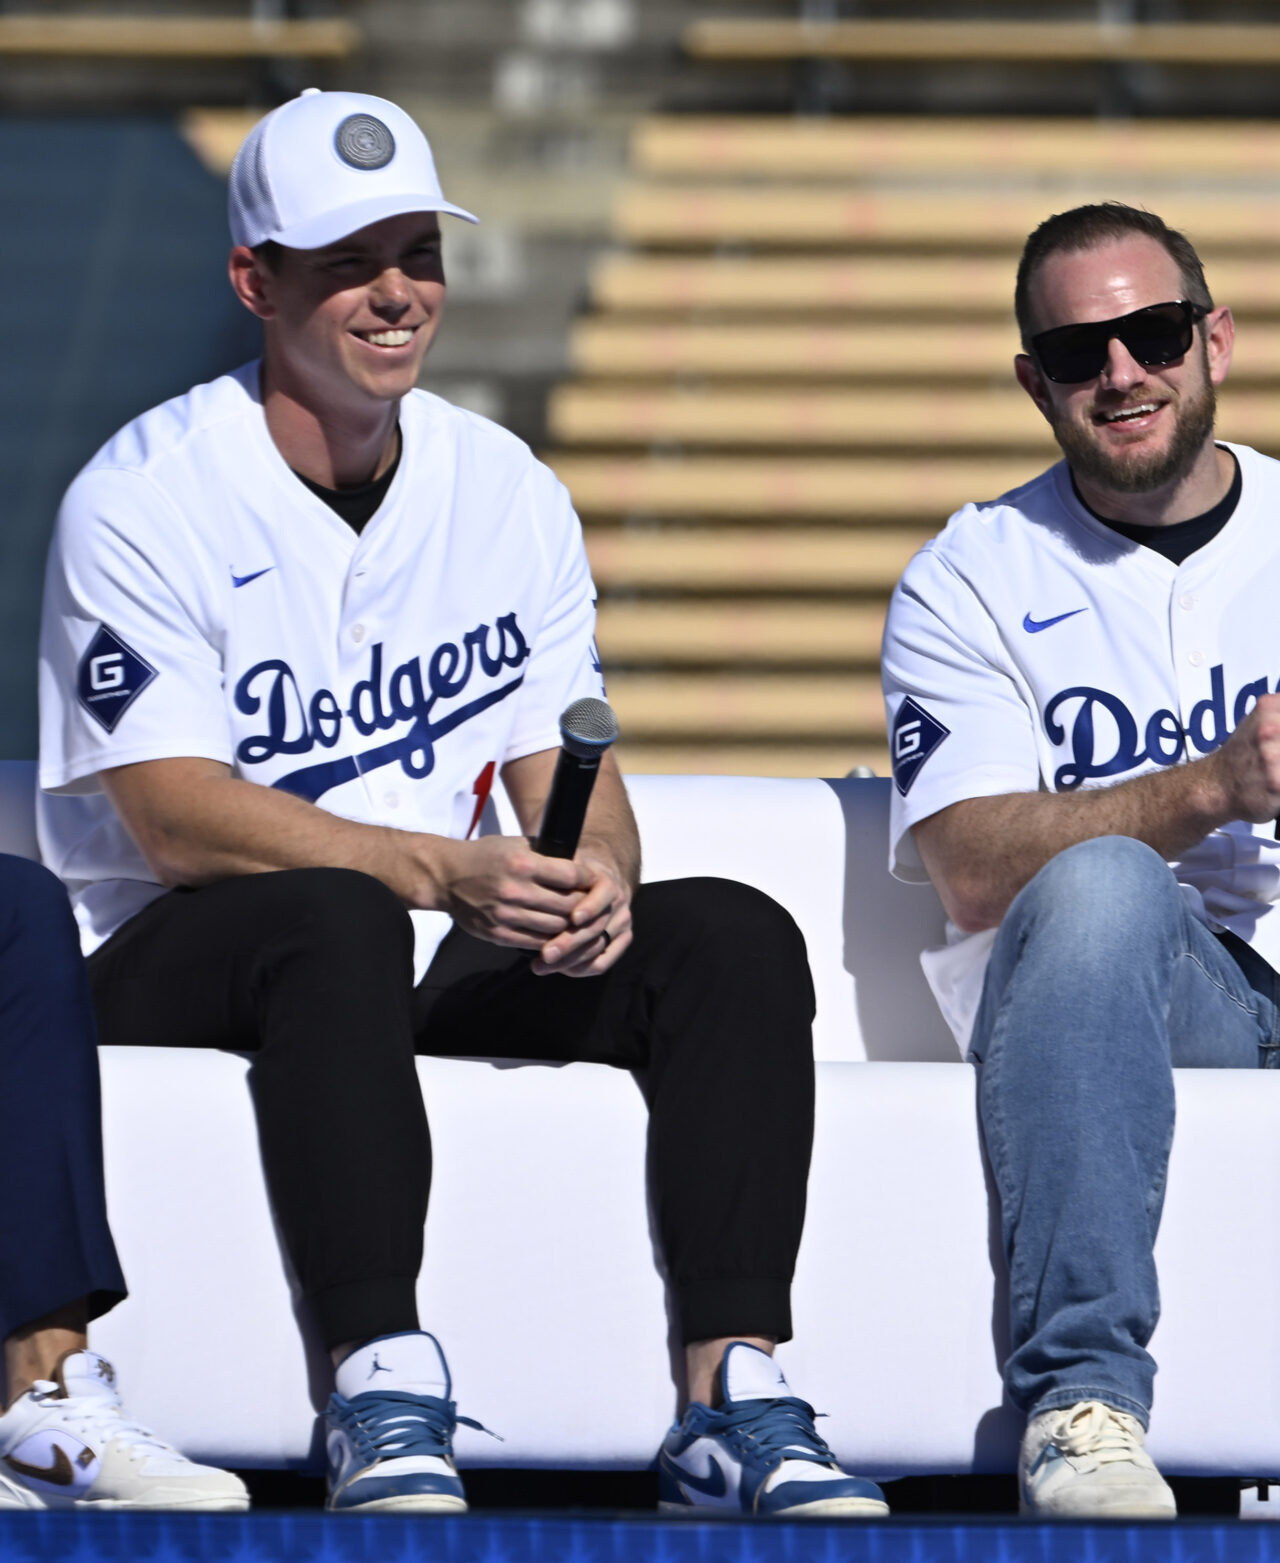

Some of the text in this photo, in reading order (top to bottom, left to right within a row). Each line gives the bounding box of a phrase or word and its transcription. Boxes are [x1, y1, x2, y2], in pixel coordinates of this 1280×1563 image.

[89, 652, 124, 691] G
[235, 612, 530, 801] Dodgers
[895, 719, 922, 759] G
